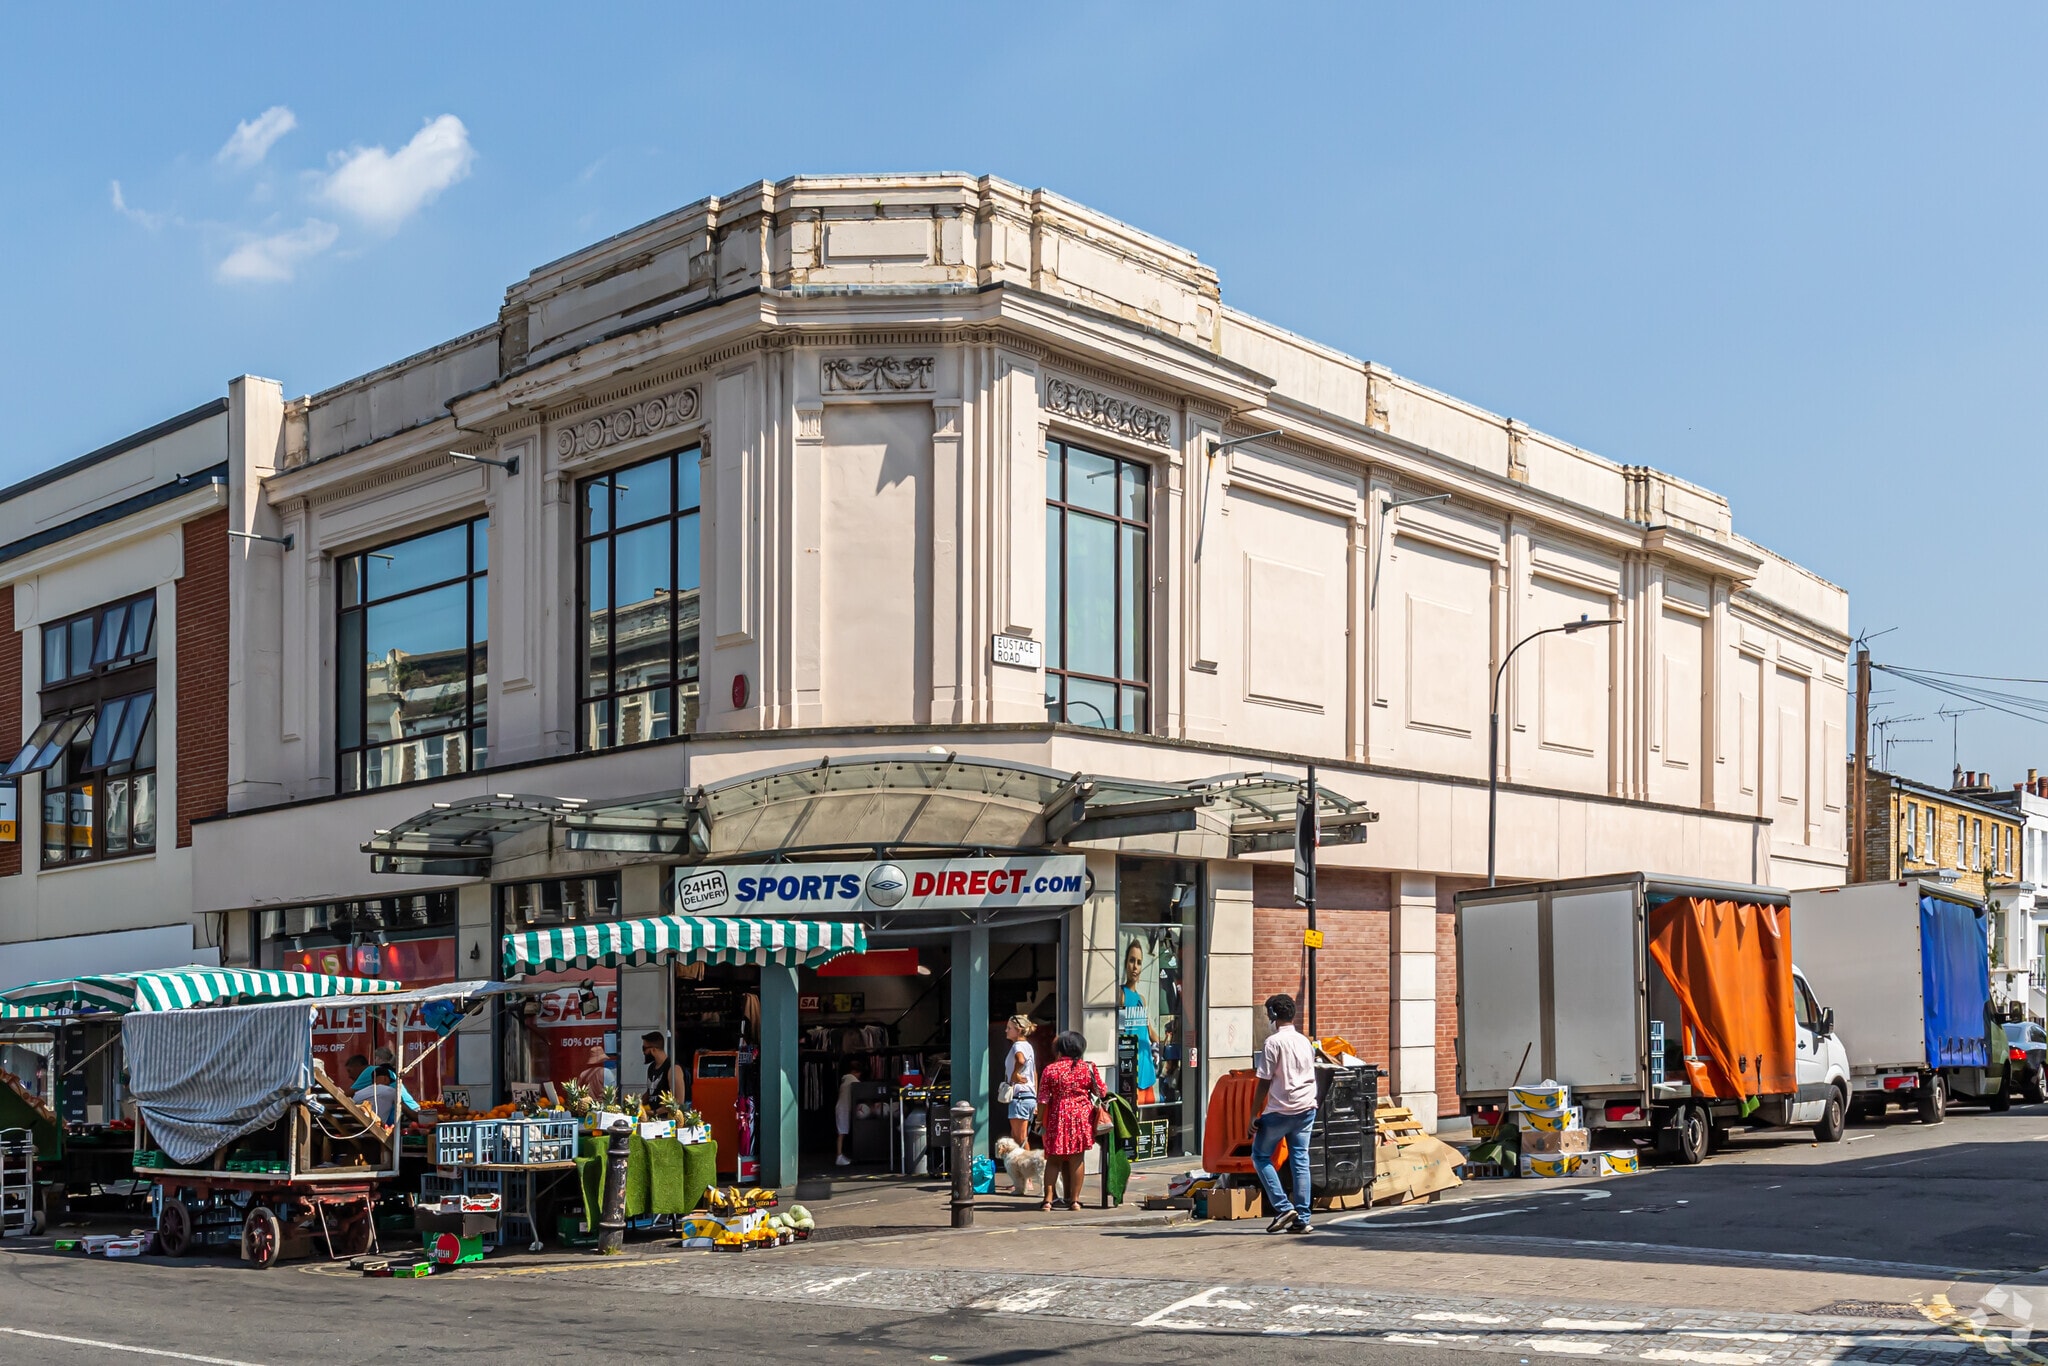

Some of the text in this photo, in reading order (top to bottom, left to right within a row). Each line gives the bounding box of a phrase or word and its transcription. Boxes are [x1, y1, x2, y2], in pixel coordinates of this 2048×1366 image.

[997, 637, 1034, 654] EUSTACE
[997, 650, 1020, 664] ROAD
[683, 876, 723, 896] 24HR
[735, 874, 861, 902] SPORTS
[684, 889, 727, 906] DELIVERY
[312, 1005, 364, 1030] ALE
[330, 1044, 345, 1052] OFF
[562, 1037, 603, 1047] 50% OFF
